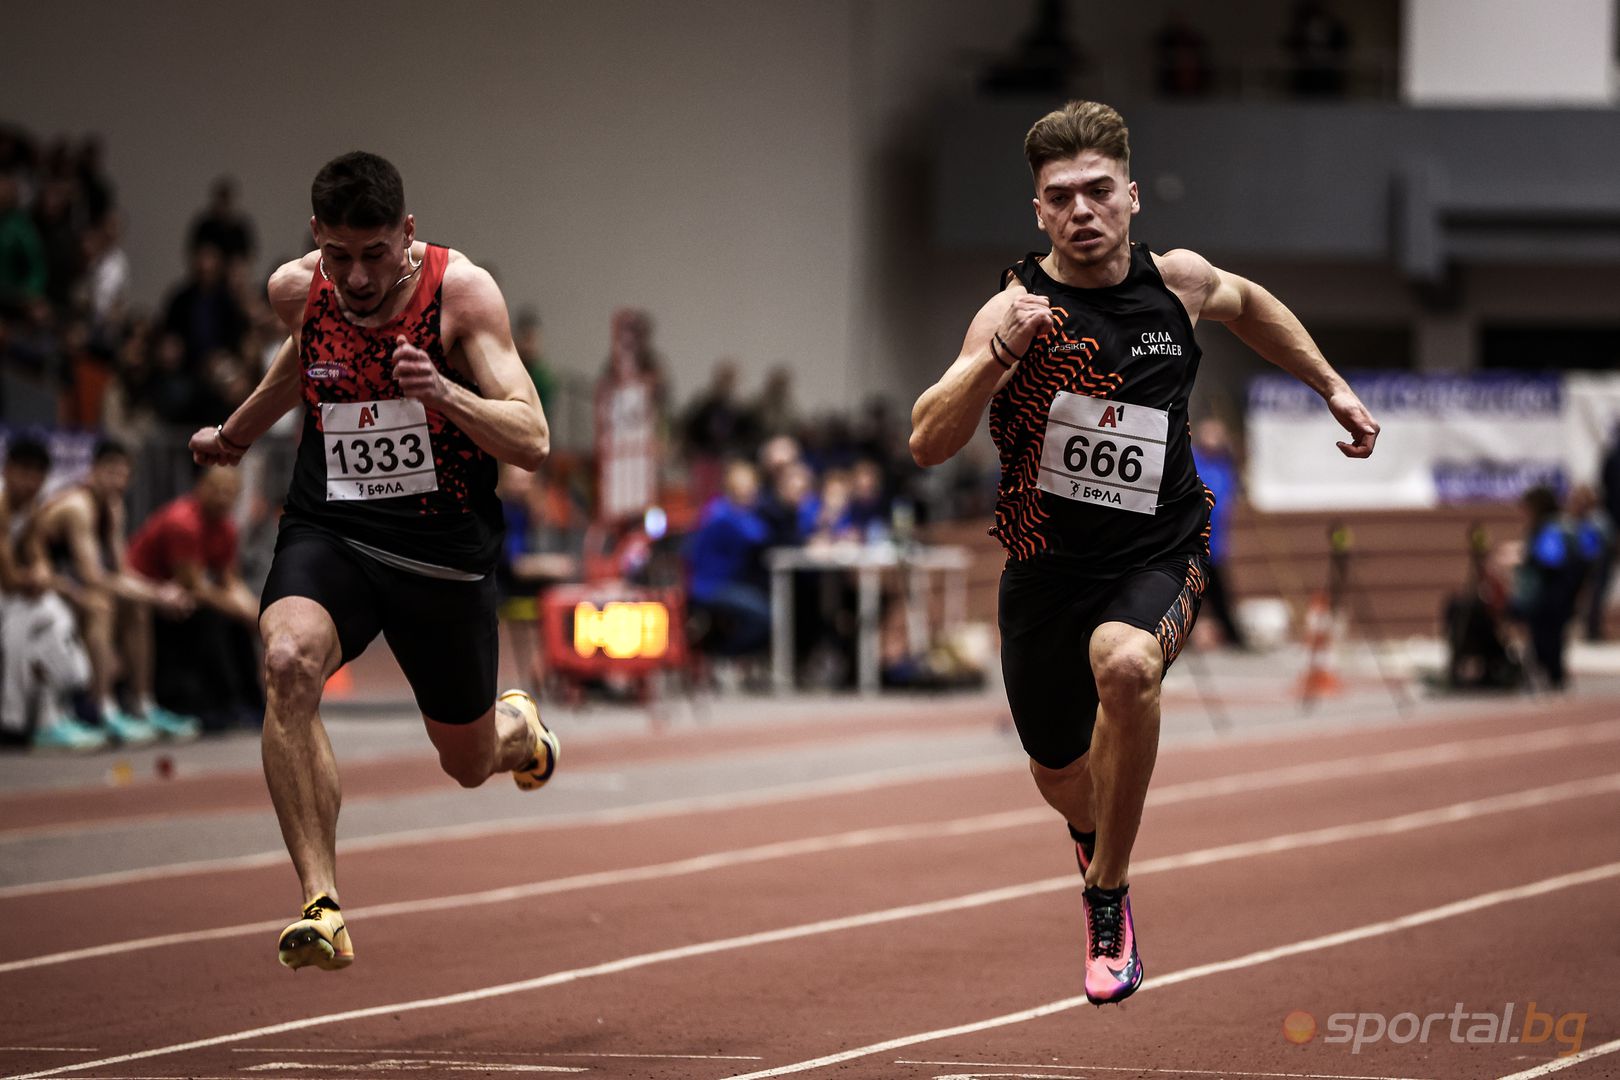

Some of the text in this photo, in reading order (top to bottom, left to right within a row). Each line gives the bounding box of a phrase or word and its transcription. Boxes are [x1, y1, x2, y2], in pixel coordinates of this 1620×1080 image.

[1141, 331, 1172, 343] СКЛА
[1131, 344, 1182, 357] М. ЖЕЛЕВ
[332, 434, 425, 474] 1333
[1063, 435, 1144, 483] 666
[368, 483, 404, 496] БФЛА
[1083, 486, 1122, 504] БФЛА
